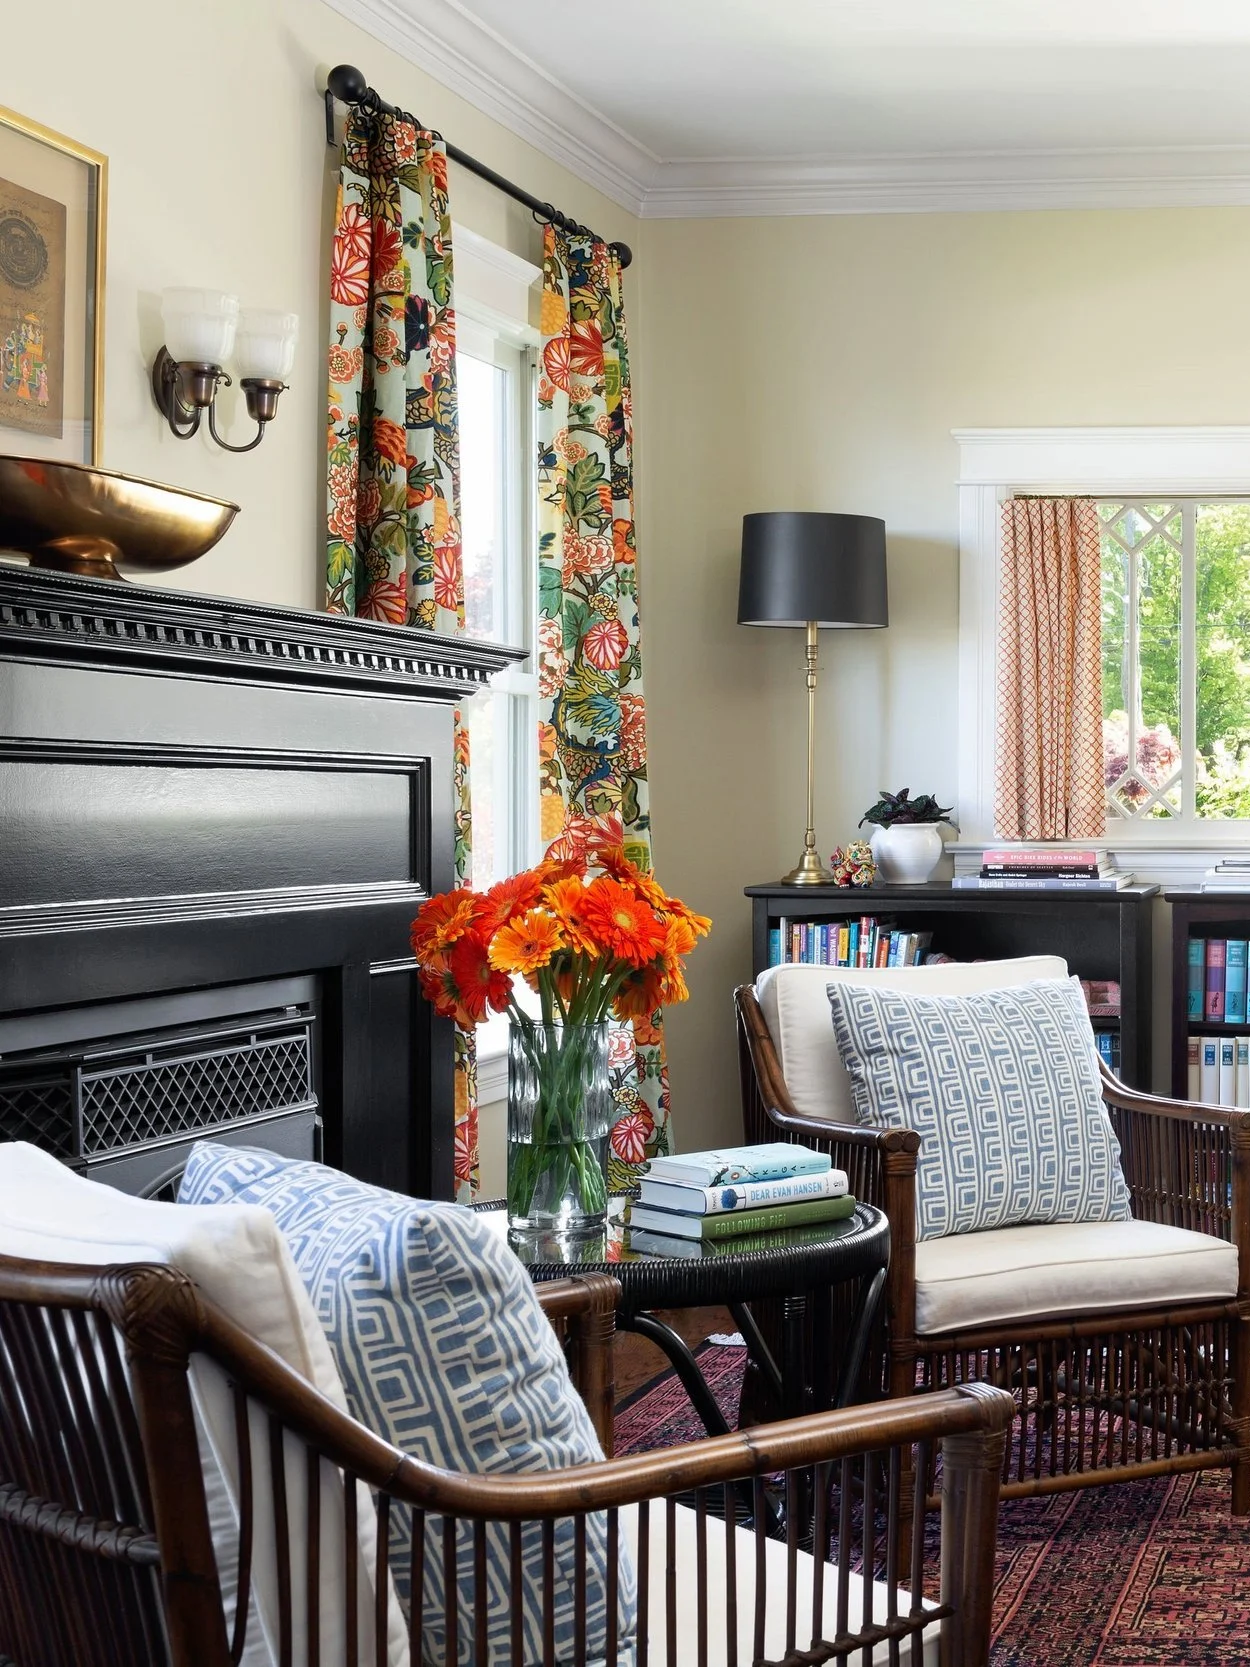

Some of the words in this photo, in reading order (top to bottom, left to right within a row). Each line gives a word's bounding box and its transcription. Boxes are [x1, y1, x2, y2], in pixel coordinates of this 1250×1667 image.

[750, 1188, 771, 1201] DEAR
[773, 1186, 792, 1198] EVAN
[793, 1182, 823, 1195] HANSEN
[715, 1216, 766, 1235] FOLLOWING
[769, 1213, 787, 1226] FIFI
